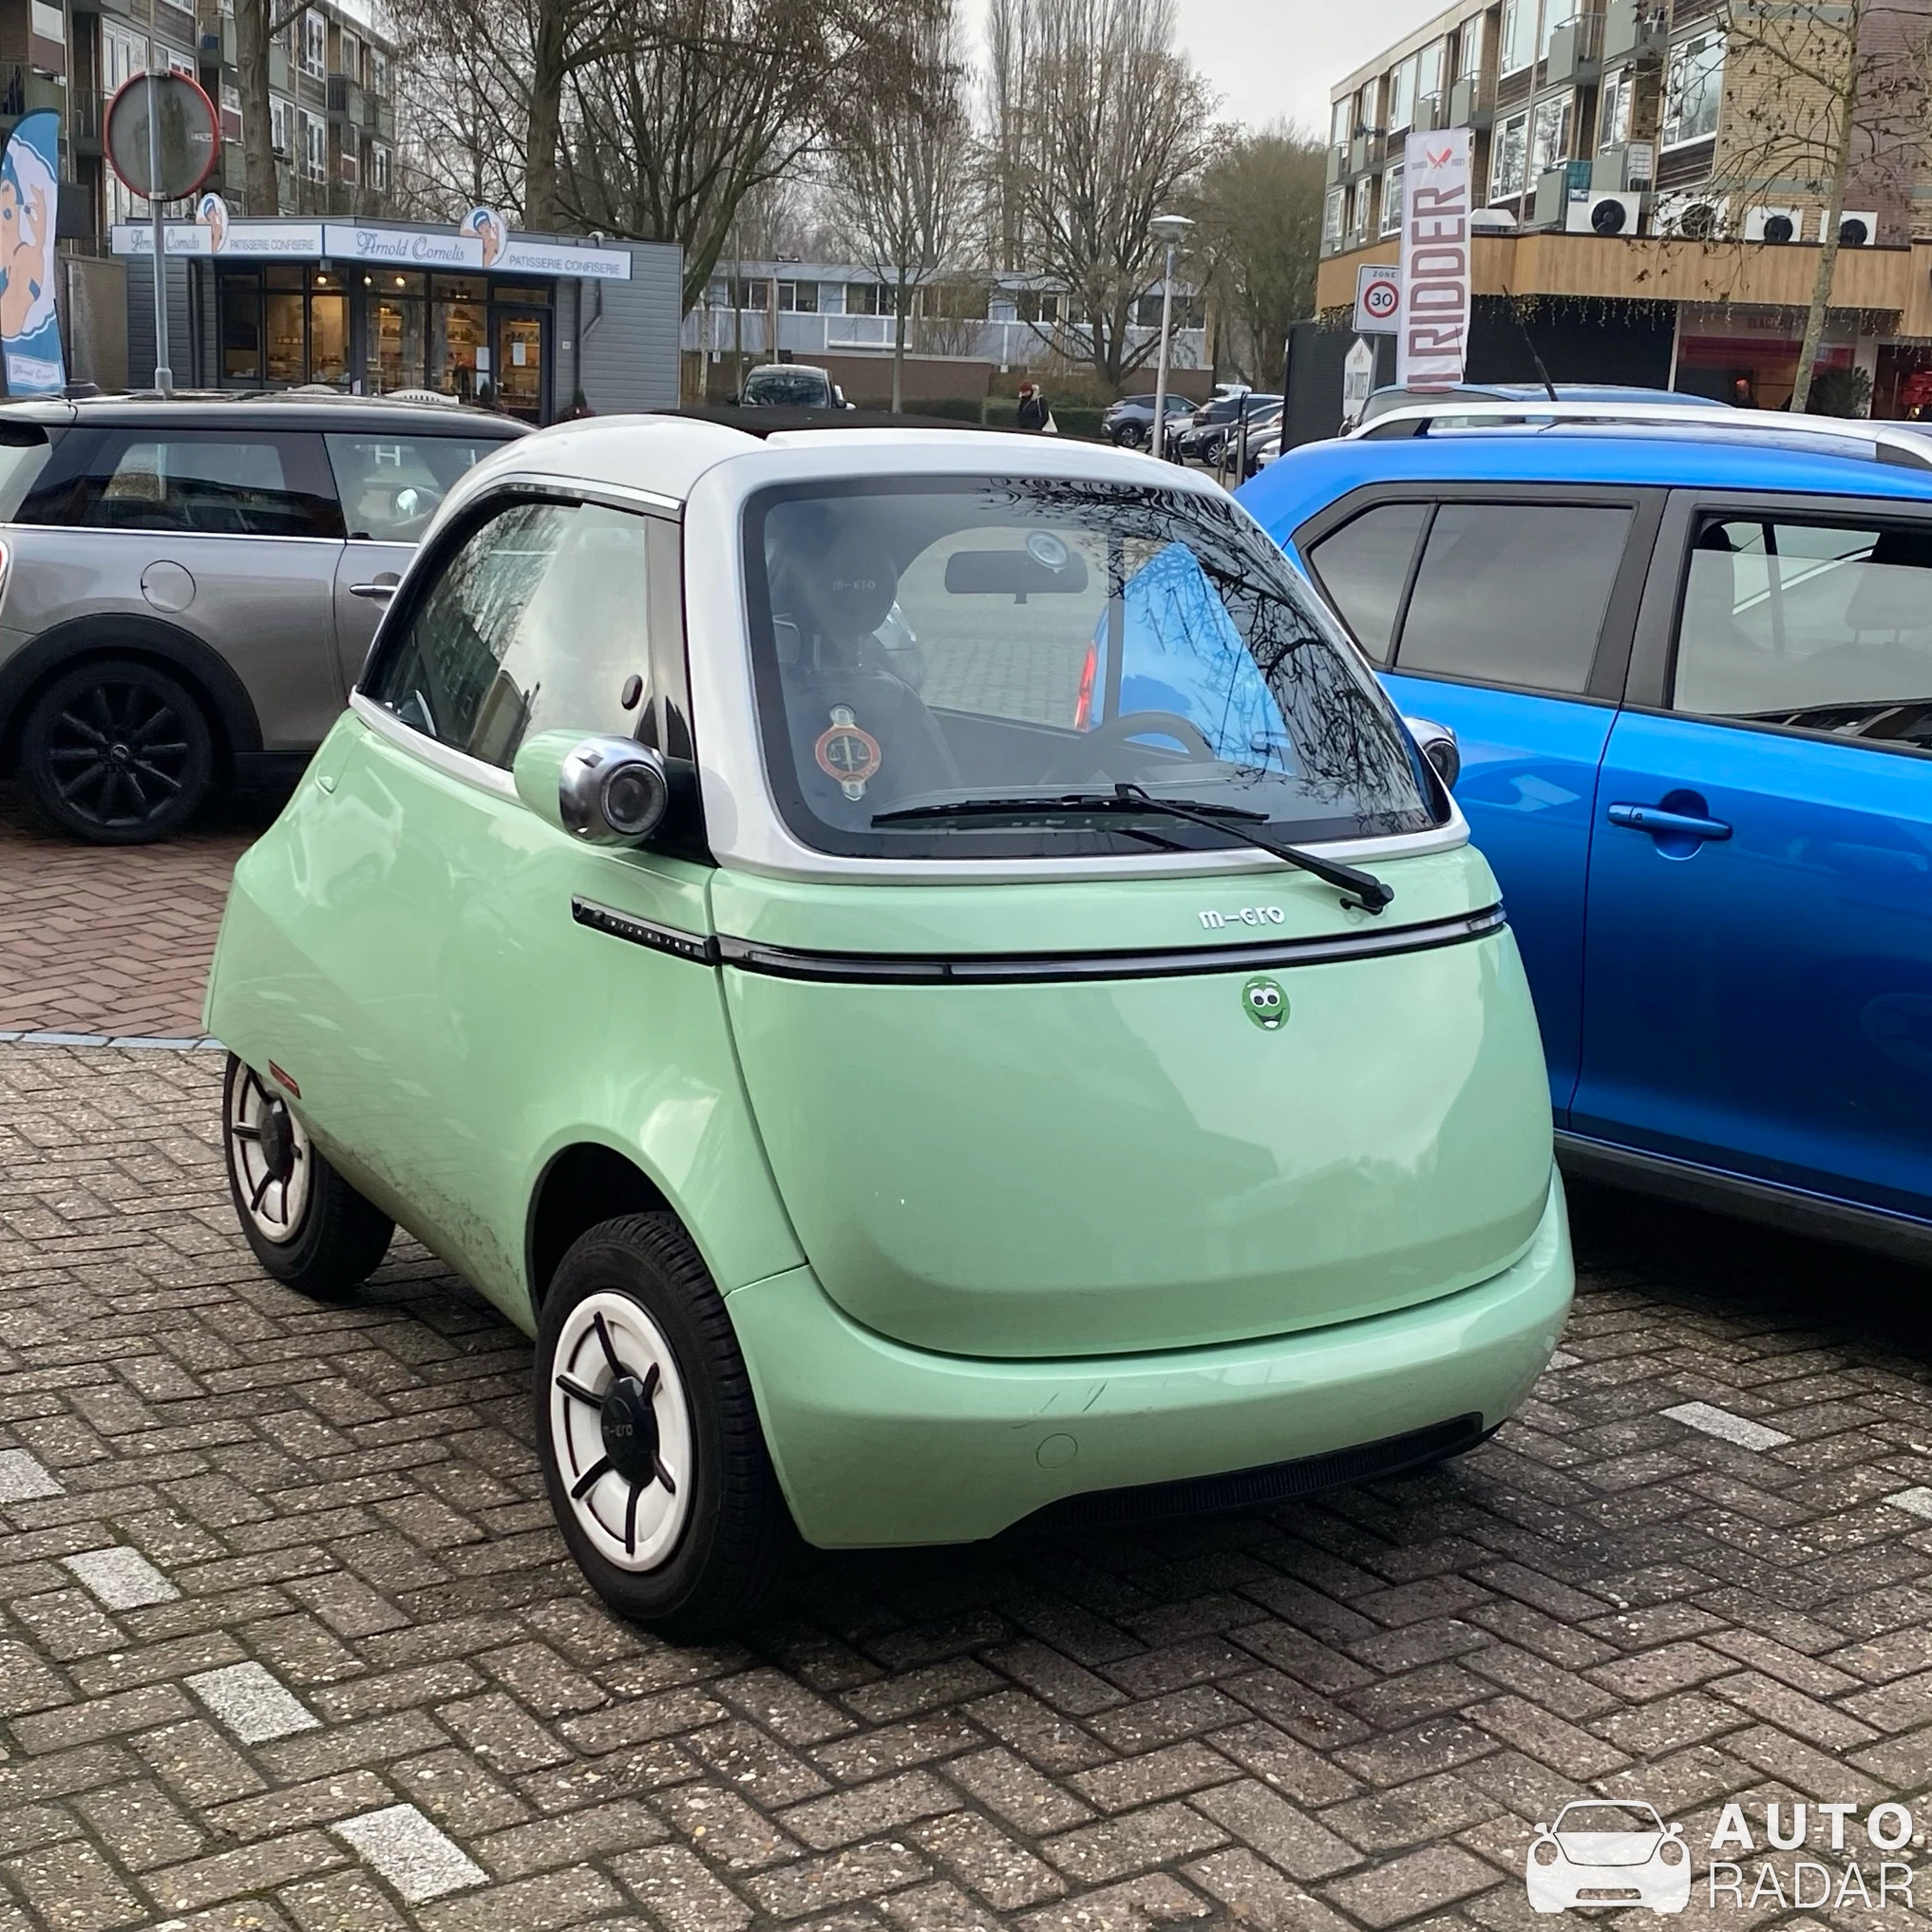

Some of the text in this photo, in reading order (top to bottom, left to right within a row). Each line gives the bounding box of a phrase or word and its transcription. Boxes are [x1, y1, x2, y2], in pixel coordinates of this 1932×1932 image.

[230, 239, 314, 251] PATISSERIE CONFISERIE
[356, 230, 464, 261] Arnold Cornelis
[509, 255, 621, 275] PATISSERIE CONFISERIE
[1409, 183, 1465, 357] RIDDER
[1372, 270, 1396, 278] ZONE
[1371, 293, 1392, 307] 30
